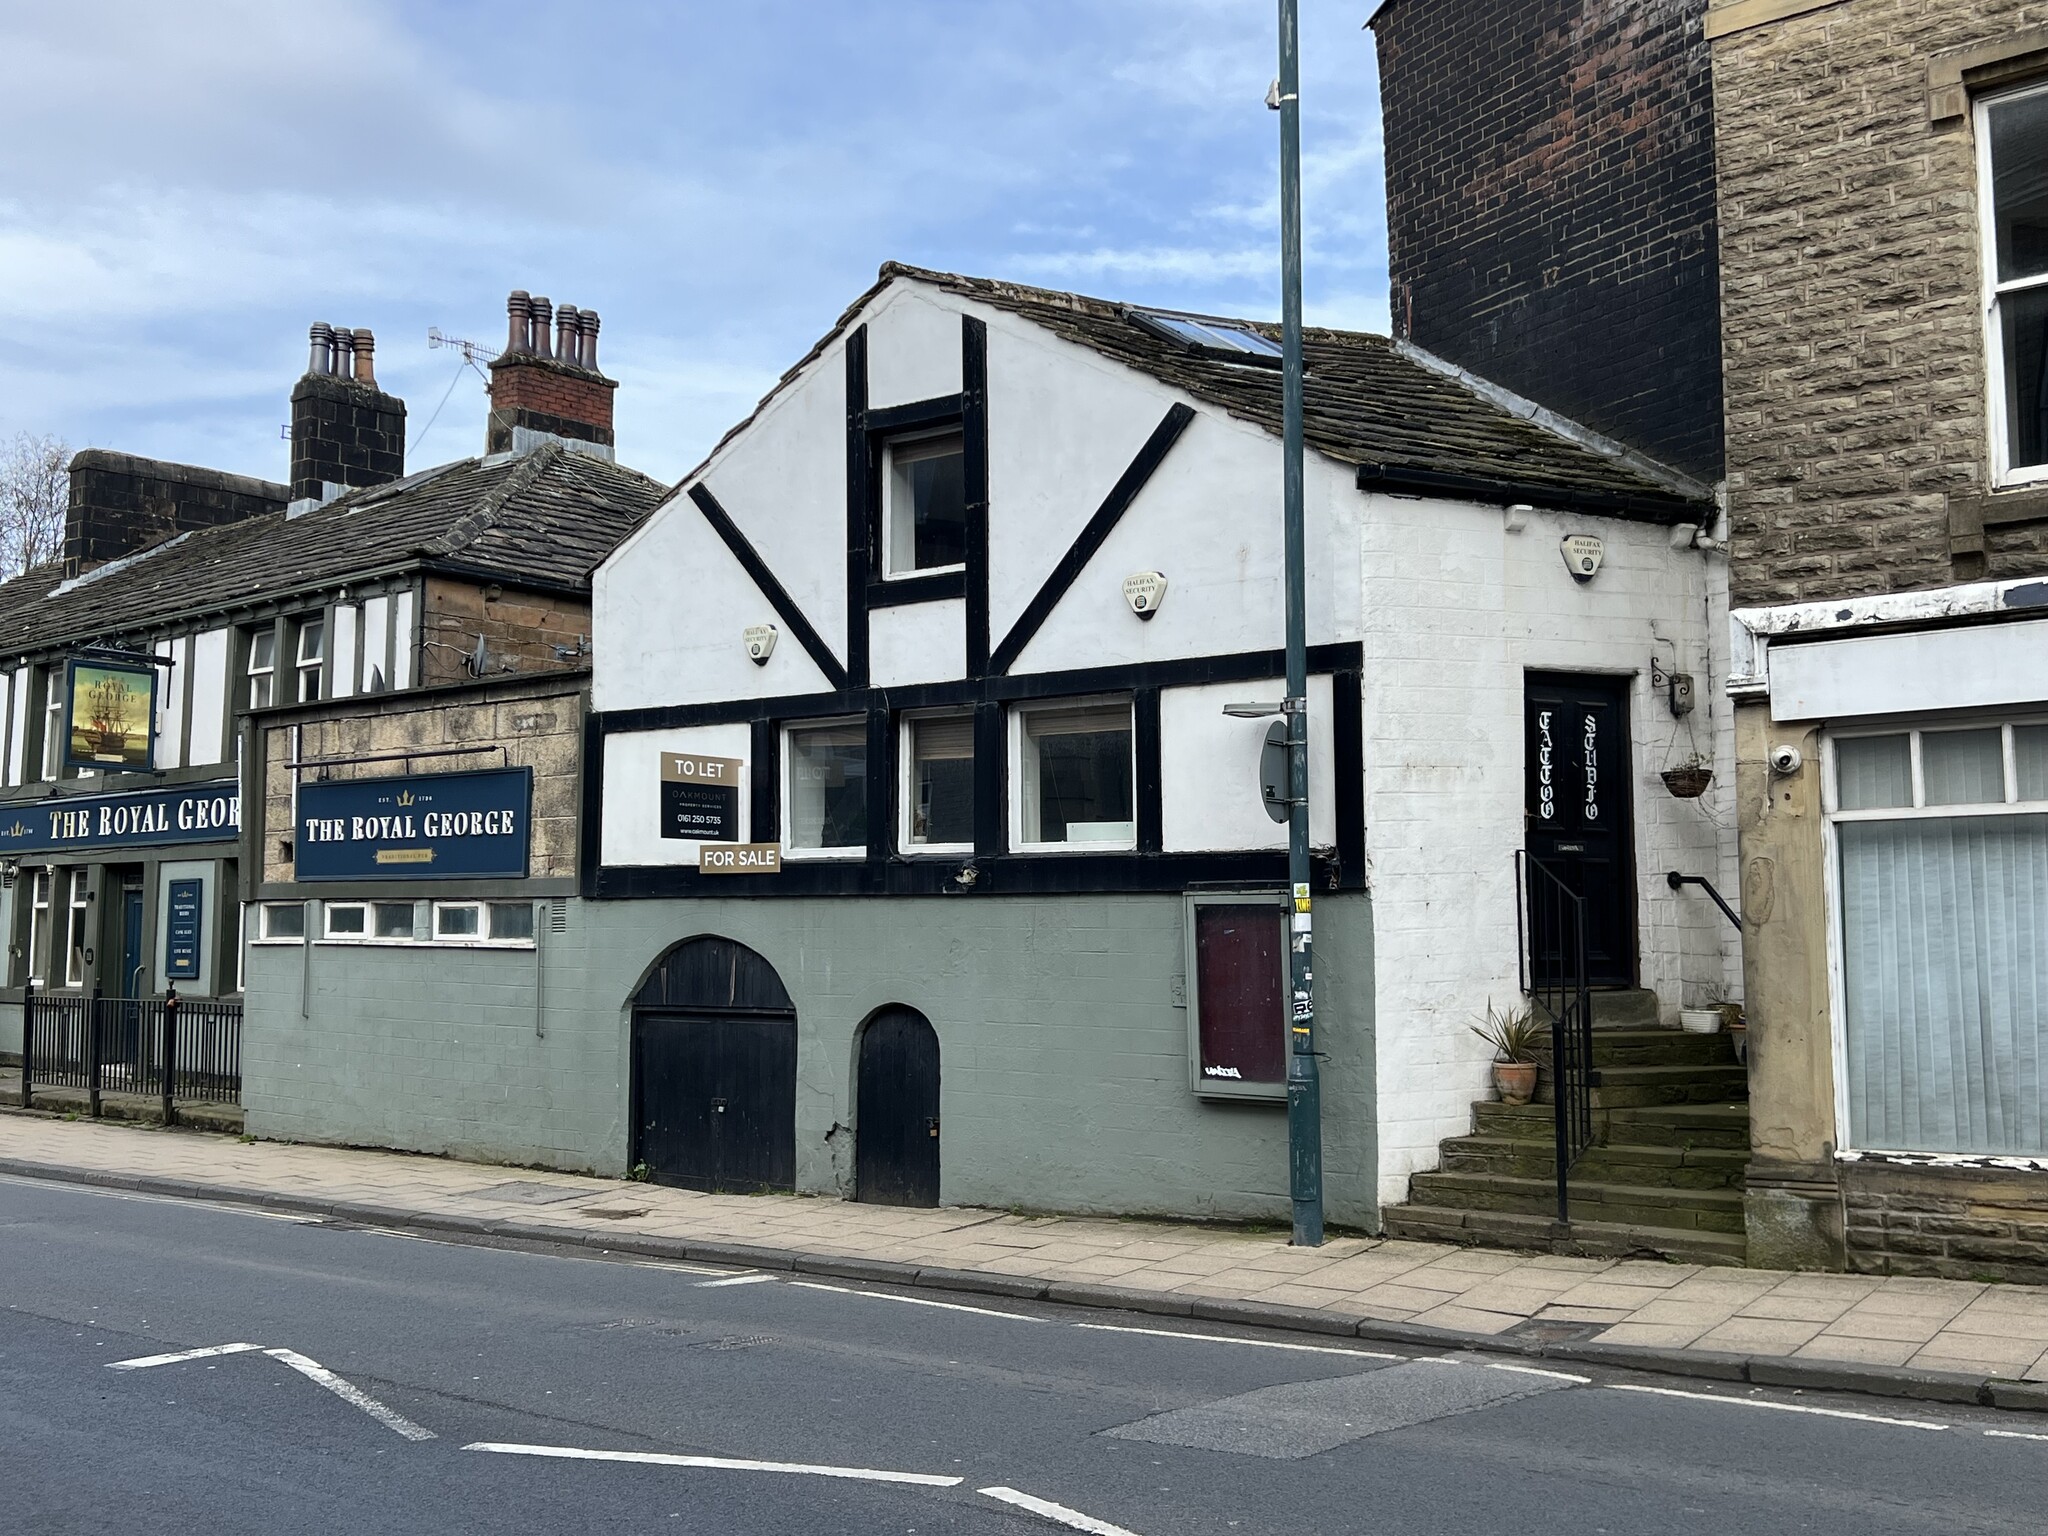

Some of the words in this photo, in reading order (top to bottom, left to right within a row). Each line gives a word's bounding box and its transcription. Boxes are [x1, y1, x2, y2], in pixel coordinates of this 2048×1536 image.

[1575, 540, 1601, 548] HALIFAX
[1573, 548, 1602, 556] SECURITY
[1127, 578, 1155, 587] HALIFAX
[1126, 586, 1155, 594] SECURITY
[94, 680, 133, 692] ROYAL
[88, 690, 137, 703] GEORGE
[674, 759, 695, 776] TO
[699, 762, 725, 778] LET
[1539, 711, 1554, 819] TATTOO
[1584, 714, 1598, 820] STUDIO
[672, 790, 727, 801] OAKMOUNT
[50, 810, 90, 839] THE
[98, 803, 169, 836] ROYAL
[178, 796, 239, 830] GEOR
[677, 814, 692, 823] 0161
[692, 815, 705, 824] 250
[706, 816, 722, 824] 5735
[306, 817, 345, 842] THE
[351, 815, 416, 840] ROYAL
[424, 810, 514, 838] GEORGE
[704, 851, 735, 866] FOR
[739, 850, 776, 866] SALE
